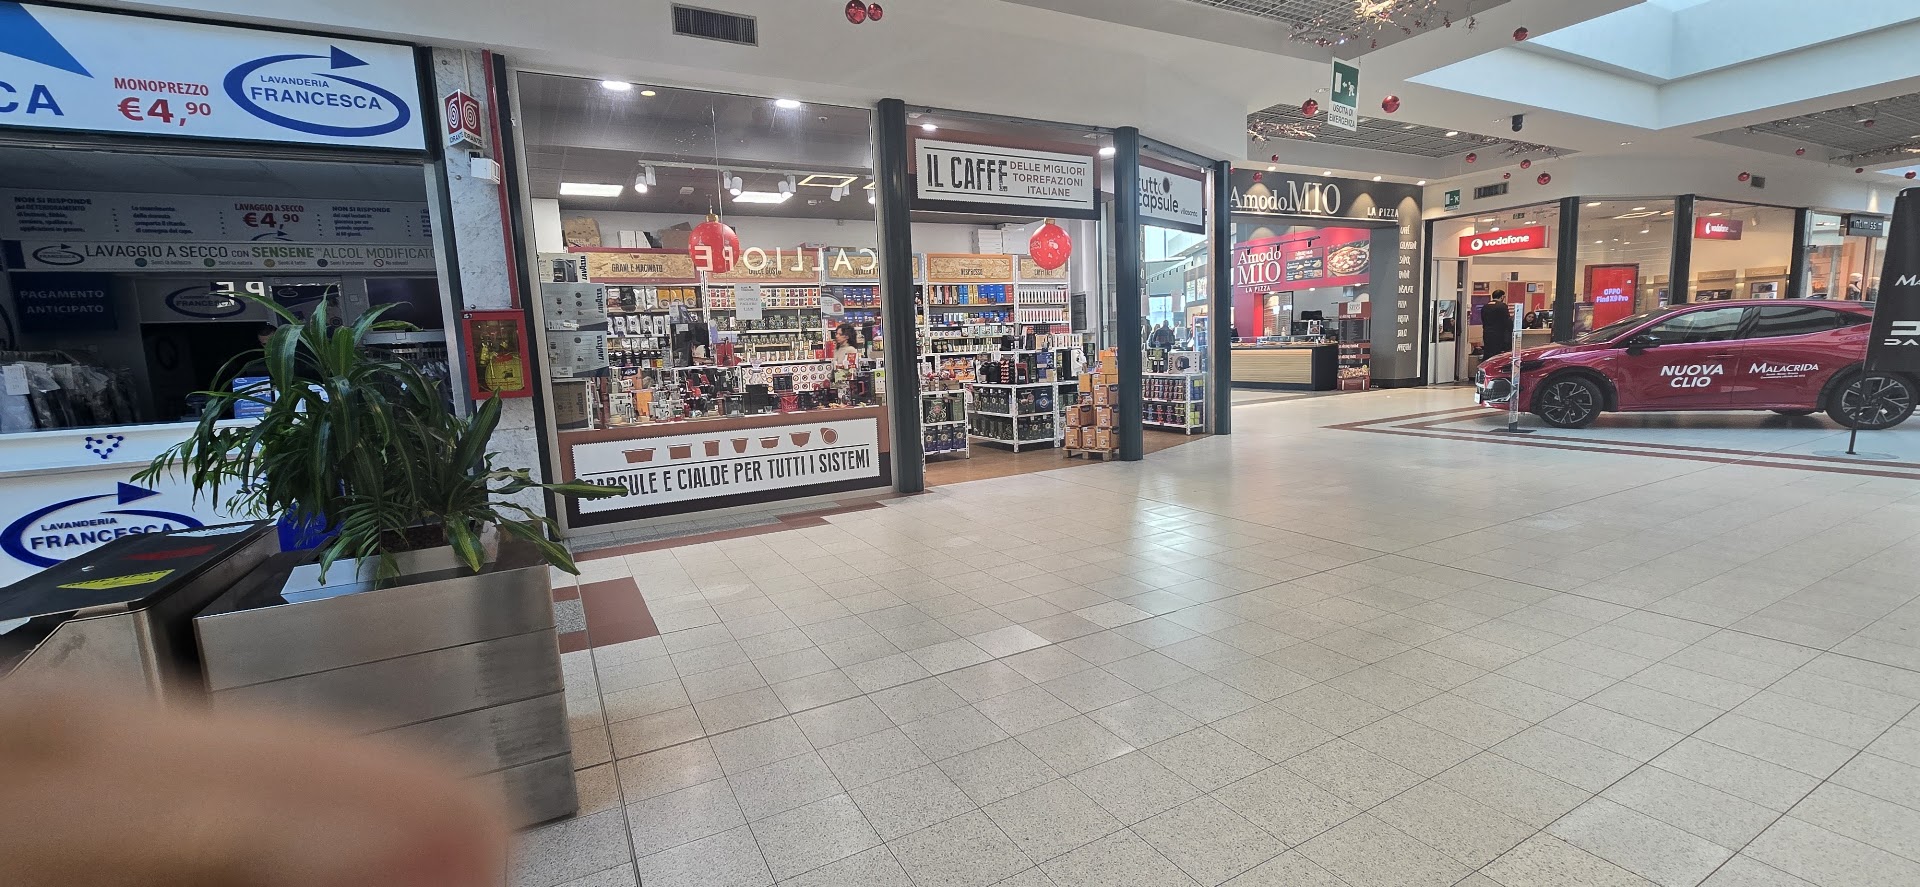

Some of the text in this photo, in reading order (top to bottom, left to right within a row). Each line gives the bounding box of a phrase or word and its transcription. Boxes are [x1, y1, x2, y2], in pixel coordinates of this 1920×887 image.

[113, 77, 209, 97] MONOPREZZO
[260, 74, 330, 89] LAVANDERIA
[250, 86, 382, 111] FRANCESCA
[117, 96, 212, 127] €4,90
[1332, 105, 1354, 117] USCITA DI
[1329, 113, 1355, 128] EMERGENZA
[926, 153, 944, 188] IL
[1010, 160, 1085, 176] DELLE MIGLIORI
[1012, 172, 1083, 187] TORREFAZIONI
[1027, 185, 1071, 197] ITALIANE
[47, 197, 92, 205] RISPONDE
[234, 203, 273, 211] LAVAGGIO
[281, 205, 304, 213] SECCO
[1367, 207, 1399, 218] LA PIZZA
[242, 212, 300, 229] €4,90
[1484, 234, 1530, 247] vodafone
[85, 245, 162, 257] LAVAGGIO
[167, 246, 176, 257] A
[180, 246, 228, 258] SECCO
[231, 250, 249, 258] CON
[252, 247, 315, 258] SENSENE
[323, 248, 363, 259] ALCOL
[1237, 246, 1282, 266] Amodo
[1237, 261, 1281, 286] MIO
[20, 290, 105, 299] PAGAMENTO
[1596, 295, 1610, 303] Find
[1618, 294, 1629, 302] Pro
[1603, 288, 1621, 296] OPPO
[27, 305, 104, 314] ANTICIPATO
[1660, 364, 1724, 377] NUOVA
[1671, 376, 1712, 389] CLIO
[663, 471, 672, 491] E
[677, 464, 730, 490] CIALDE
[734, 460, 763, 484] PER
[768, 455, 806, 479] TUTTI
[808, 455, 814, 475] I
[819, 449, 871, 474] SISTEMI
[40, 517, 118, 531] LAVANDERIA
